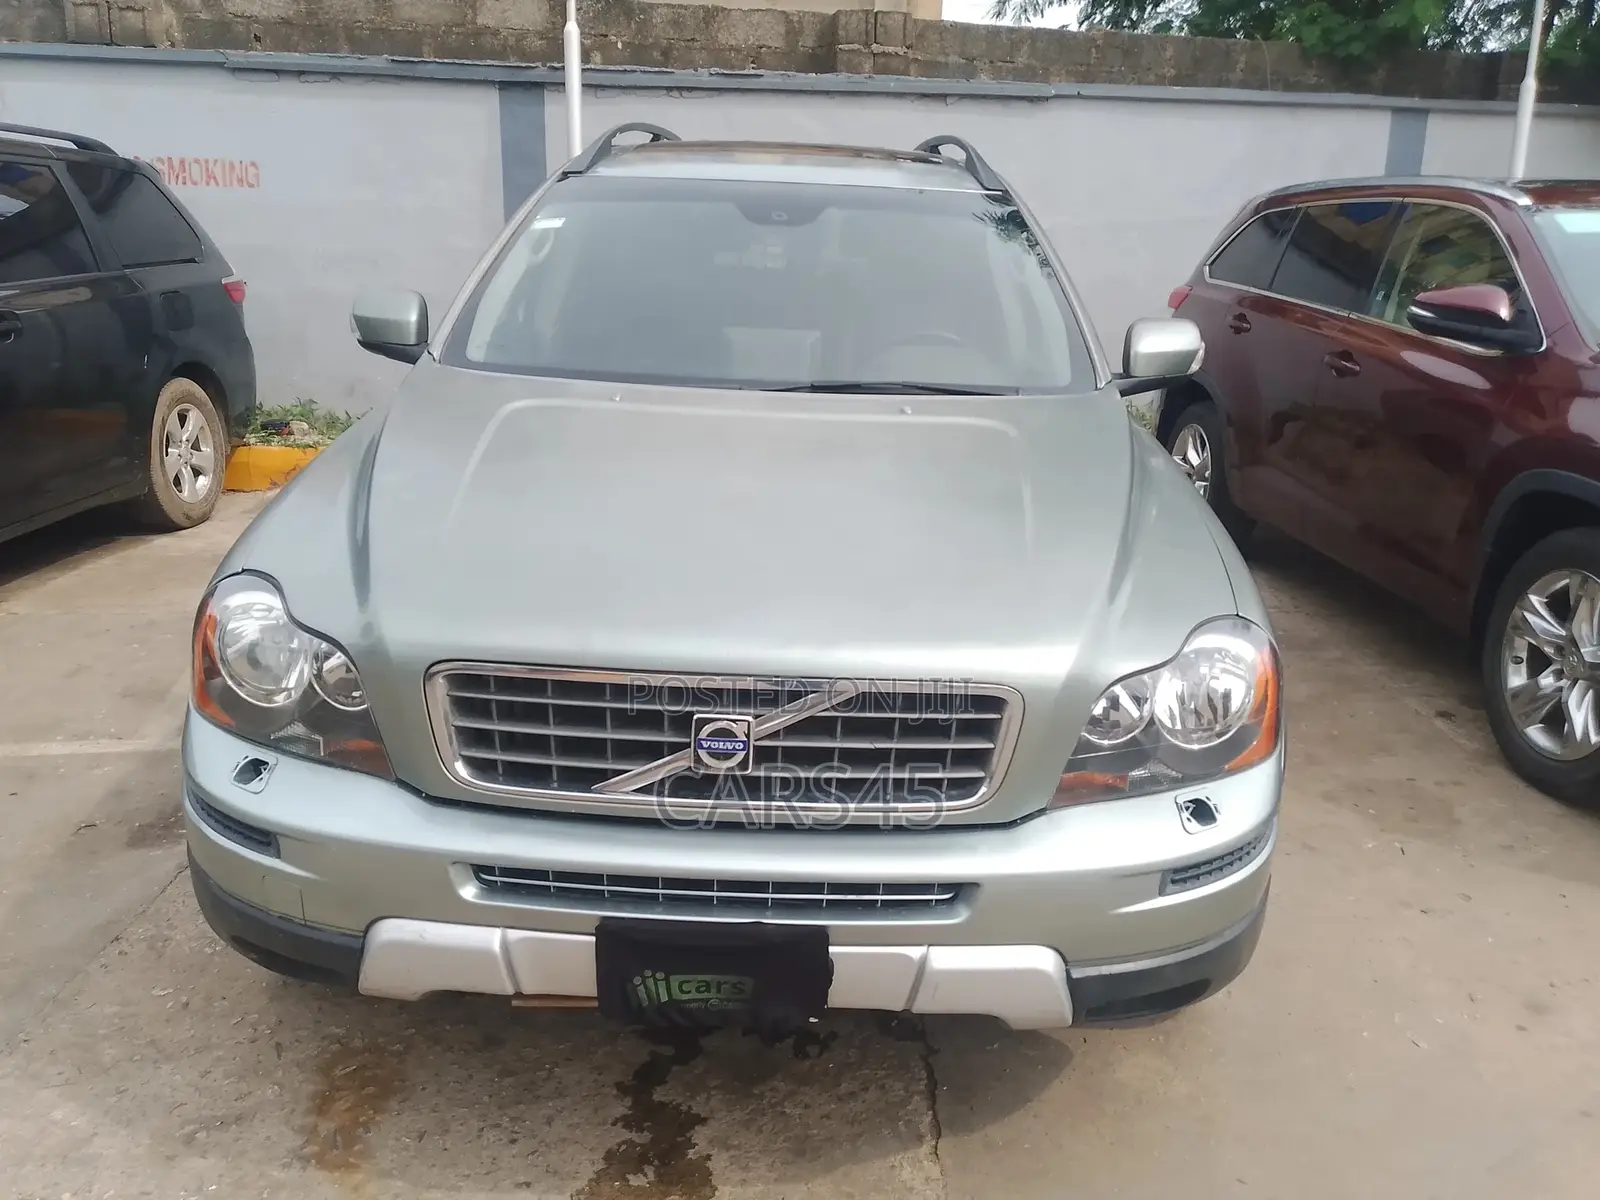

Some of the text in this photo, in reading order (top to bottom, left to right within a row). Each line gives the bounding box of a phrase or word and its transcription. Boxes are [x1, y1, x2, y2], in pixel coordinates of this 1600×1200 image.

[152, 155, 261, 189] SMOKING
[700, 740, 744, 750] VOLVO
[677, 978, 746, 995] cars
